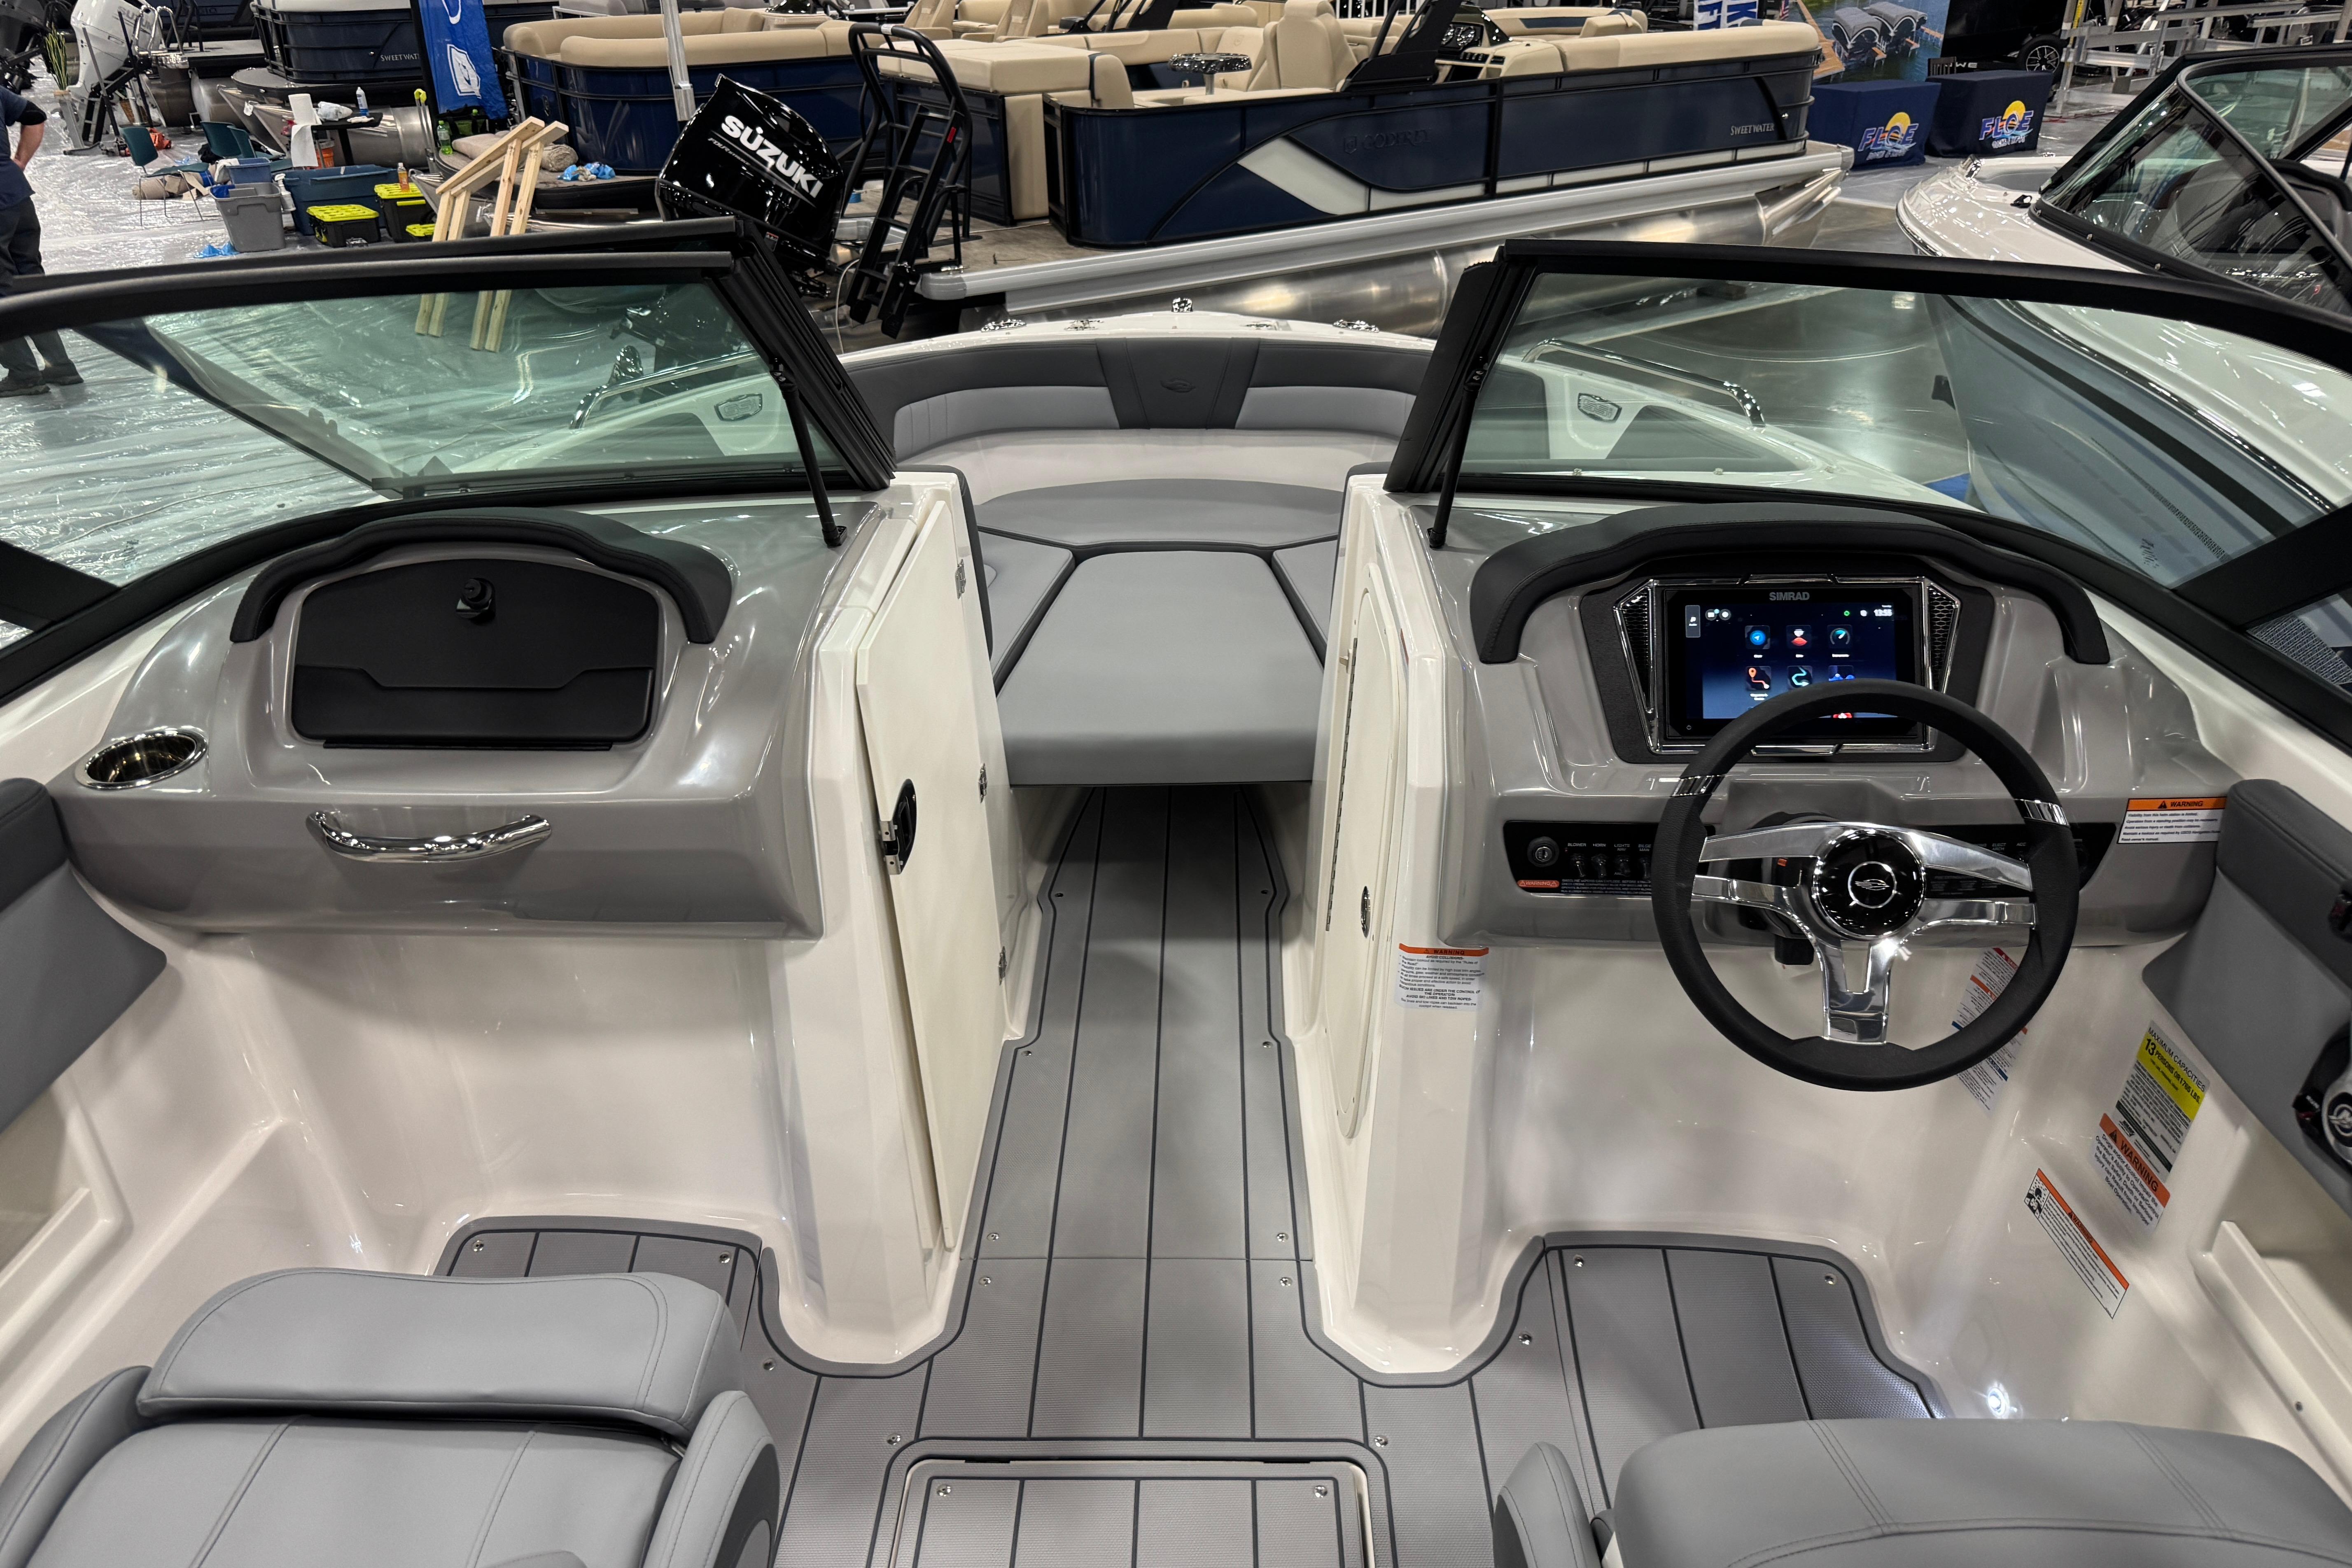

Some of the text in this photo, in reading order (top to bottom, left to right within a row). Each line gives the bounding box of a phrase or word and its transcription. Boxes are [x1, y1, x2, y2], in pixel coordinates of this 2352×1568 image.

[1730, 123, 1774, 135] SWEETWATER
[1858, 124, 1919, 152] FLOE
[1979, 110, 2034, 140] FLOE
[721, 115, 823, 198] SUZUKI
[1769, 592, 1810, 601] SIMRAD
[2143, 1036, 2157, 1057] 13
[2154, 1049, 2175, 1075] PERSONS
[2148, 1027, 2173, 1057] MAXIMUM
[2173, 1054, 2205, 1093] CAPACITIES
[2119, 1140, 2159, 1192] WARNING
